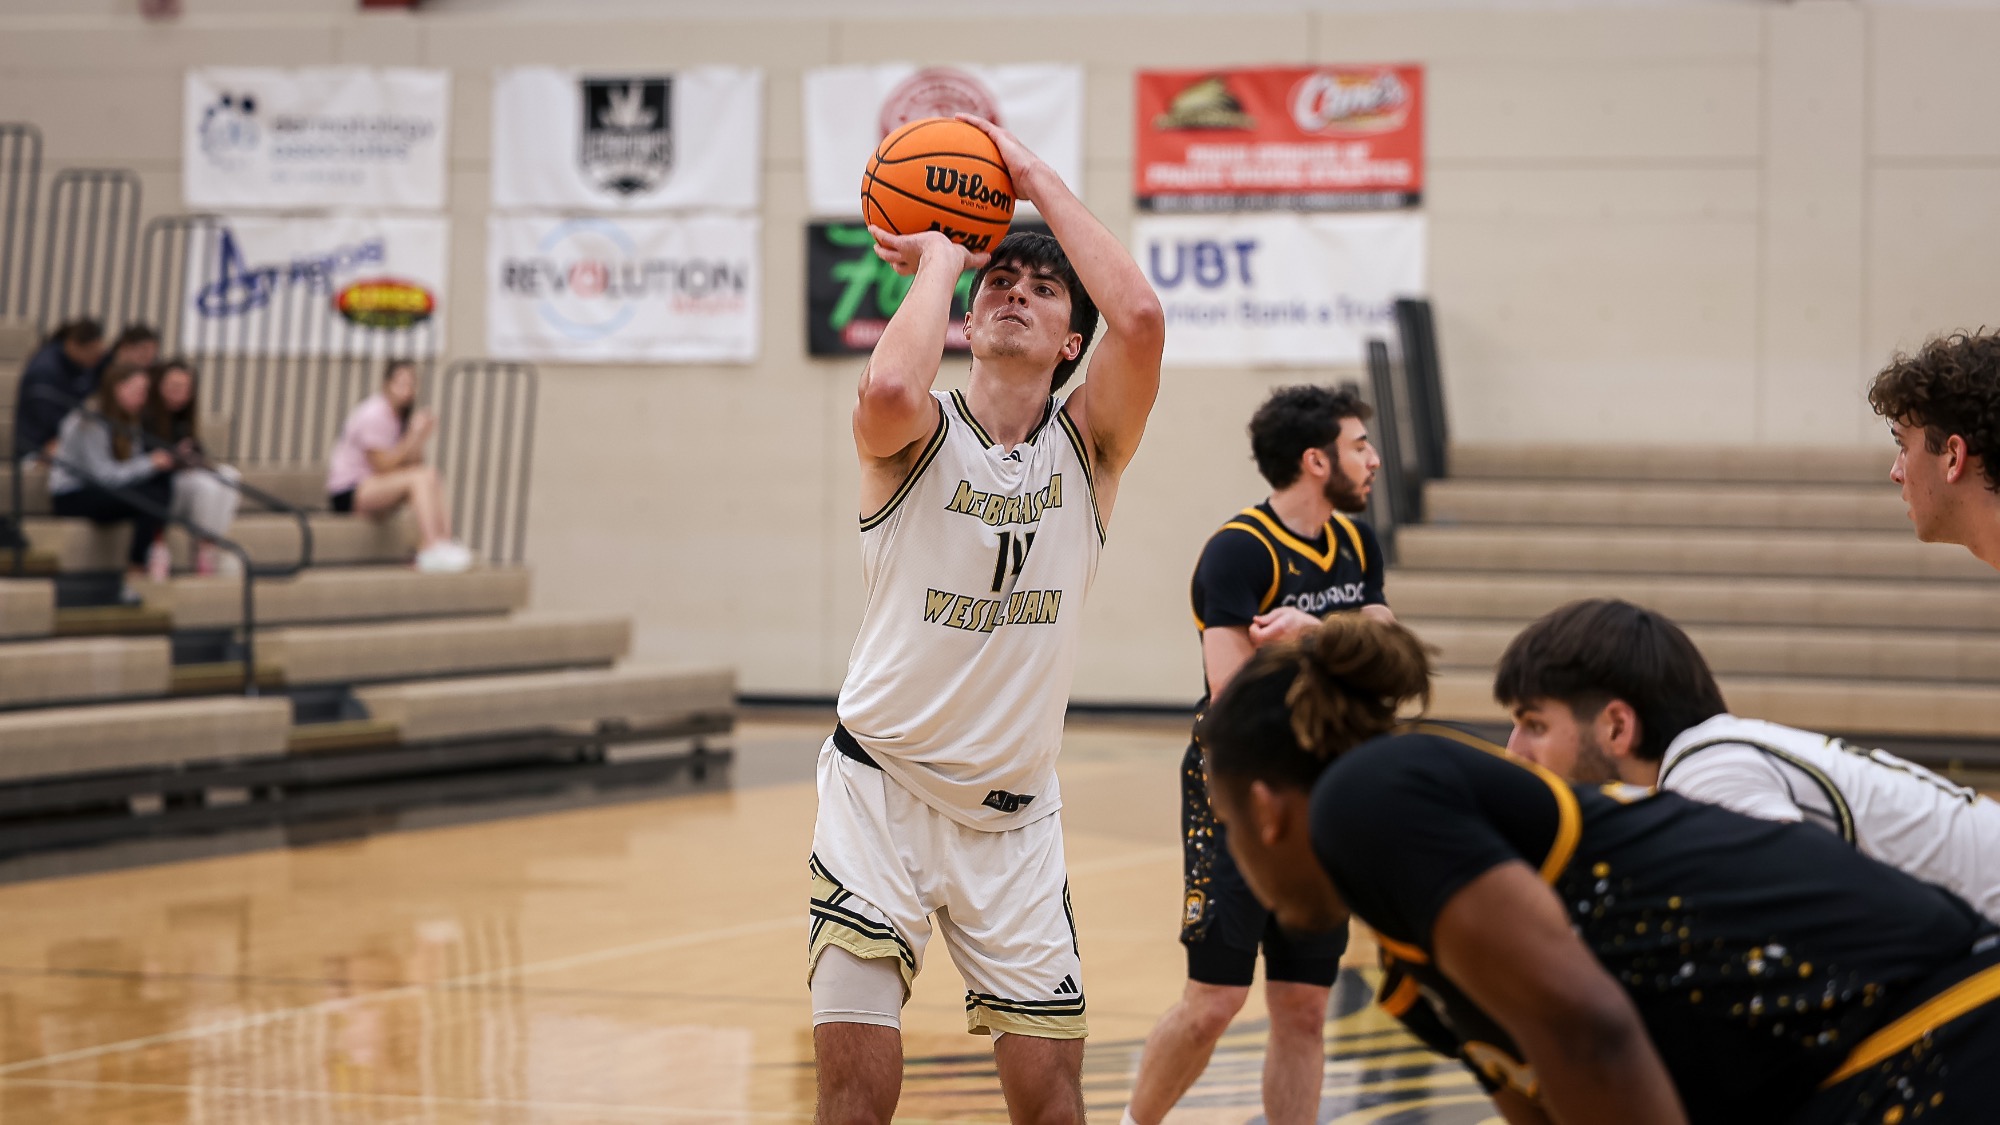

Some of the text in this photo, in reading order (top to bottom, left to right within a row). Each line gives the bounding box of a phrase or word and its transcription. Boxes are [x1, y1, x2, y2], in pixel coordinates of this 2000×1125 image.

[925, 165, 1011, 213] Wilson
[503, 257, 746, 297] REVOLUTION
[1150, 239, 1255, 288] UBT
